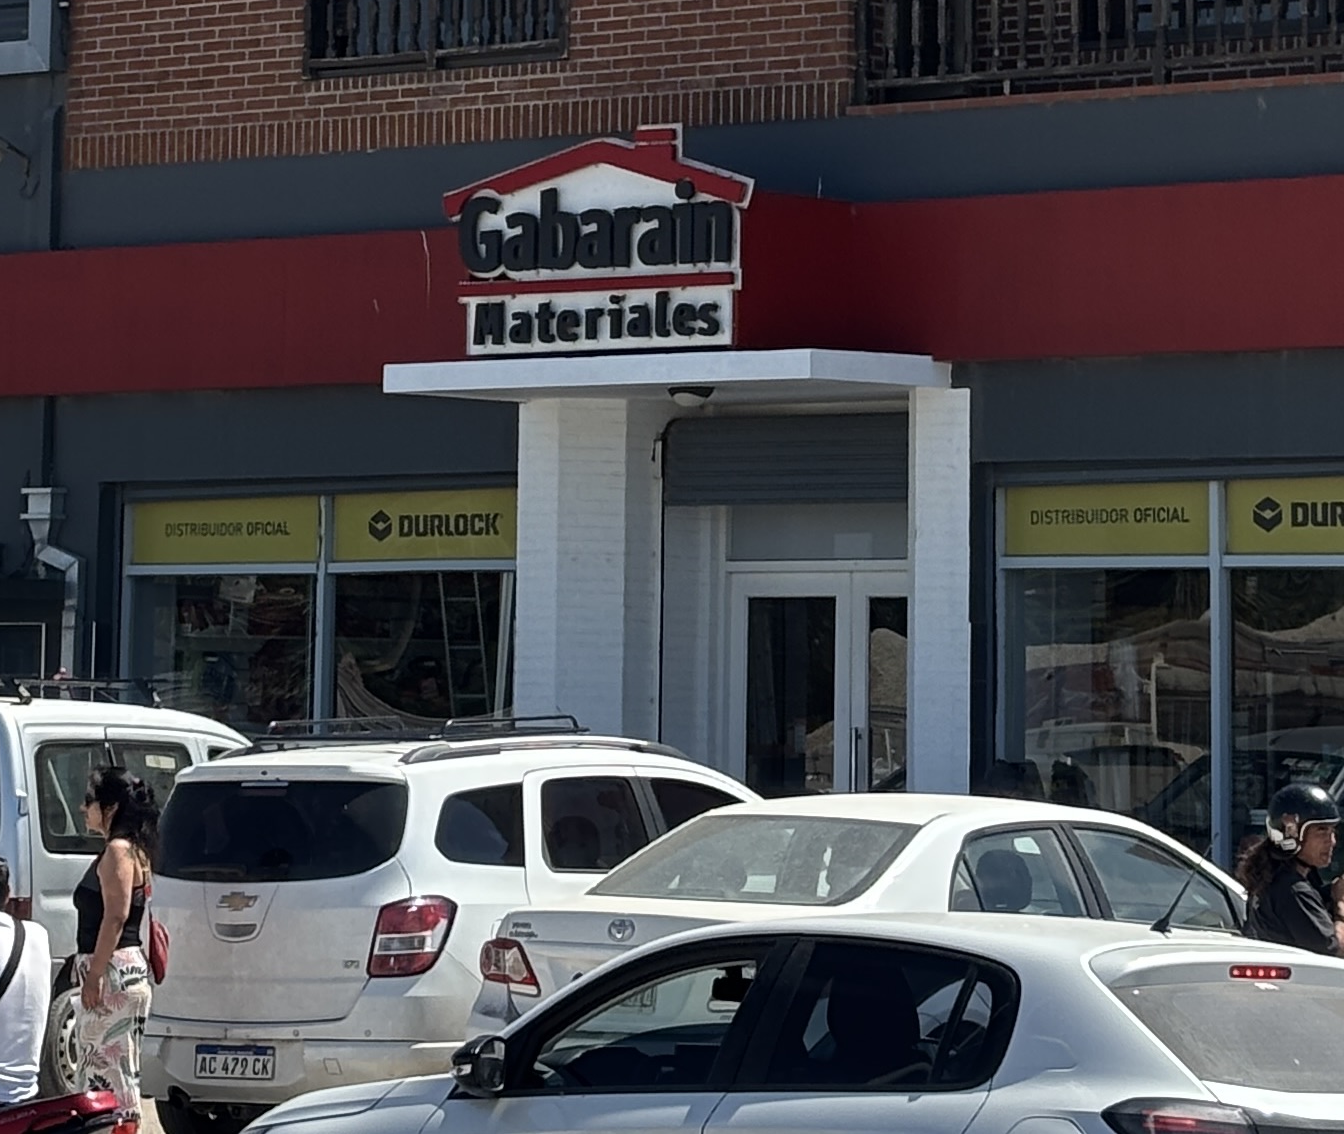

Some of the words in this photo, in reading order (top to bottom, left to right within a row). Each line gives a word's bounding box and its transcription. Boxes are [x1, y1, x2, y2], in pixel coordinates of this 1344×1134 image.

[460, 179, 734, 274] Gabarain
[473, 291, 722, 347] Materiales
[399, 512, 500, 537] DURLOCK
[1030, 508, 1129, 525] DISTRIBUIDOR
[1133, 506, 1190, 523] OFICIAL
[165, 522, 244, 537] DISTRIBUIDOR
[246, 520, 291, 536] OFICIAL
[199, 1056, 217, 1074] AC
[252, 1058, 271, 1076] CK
